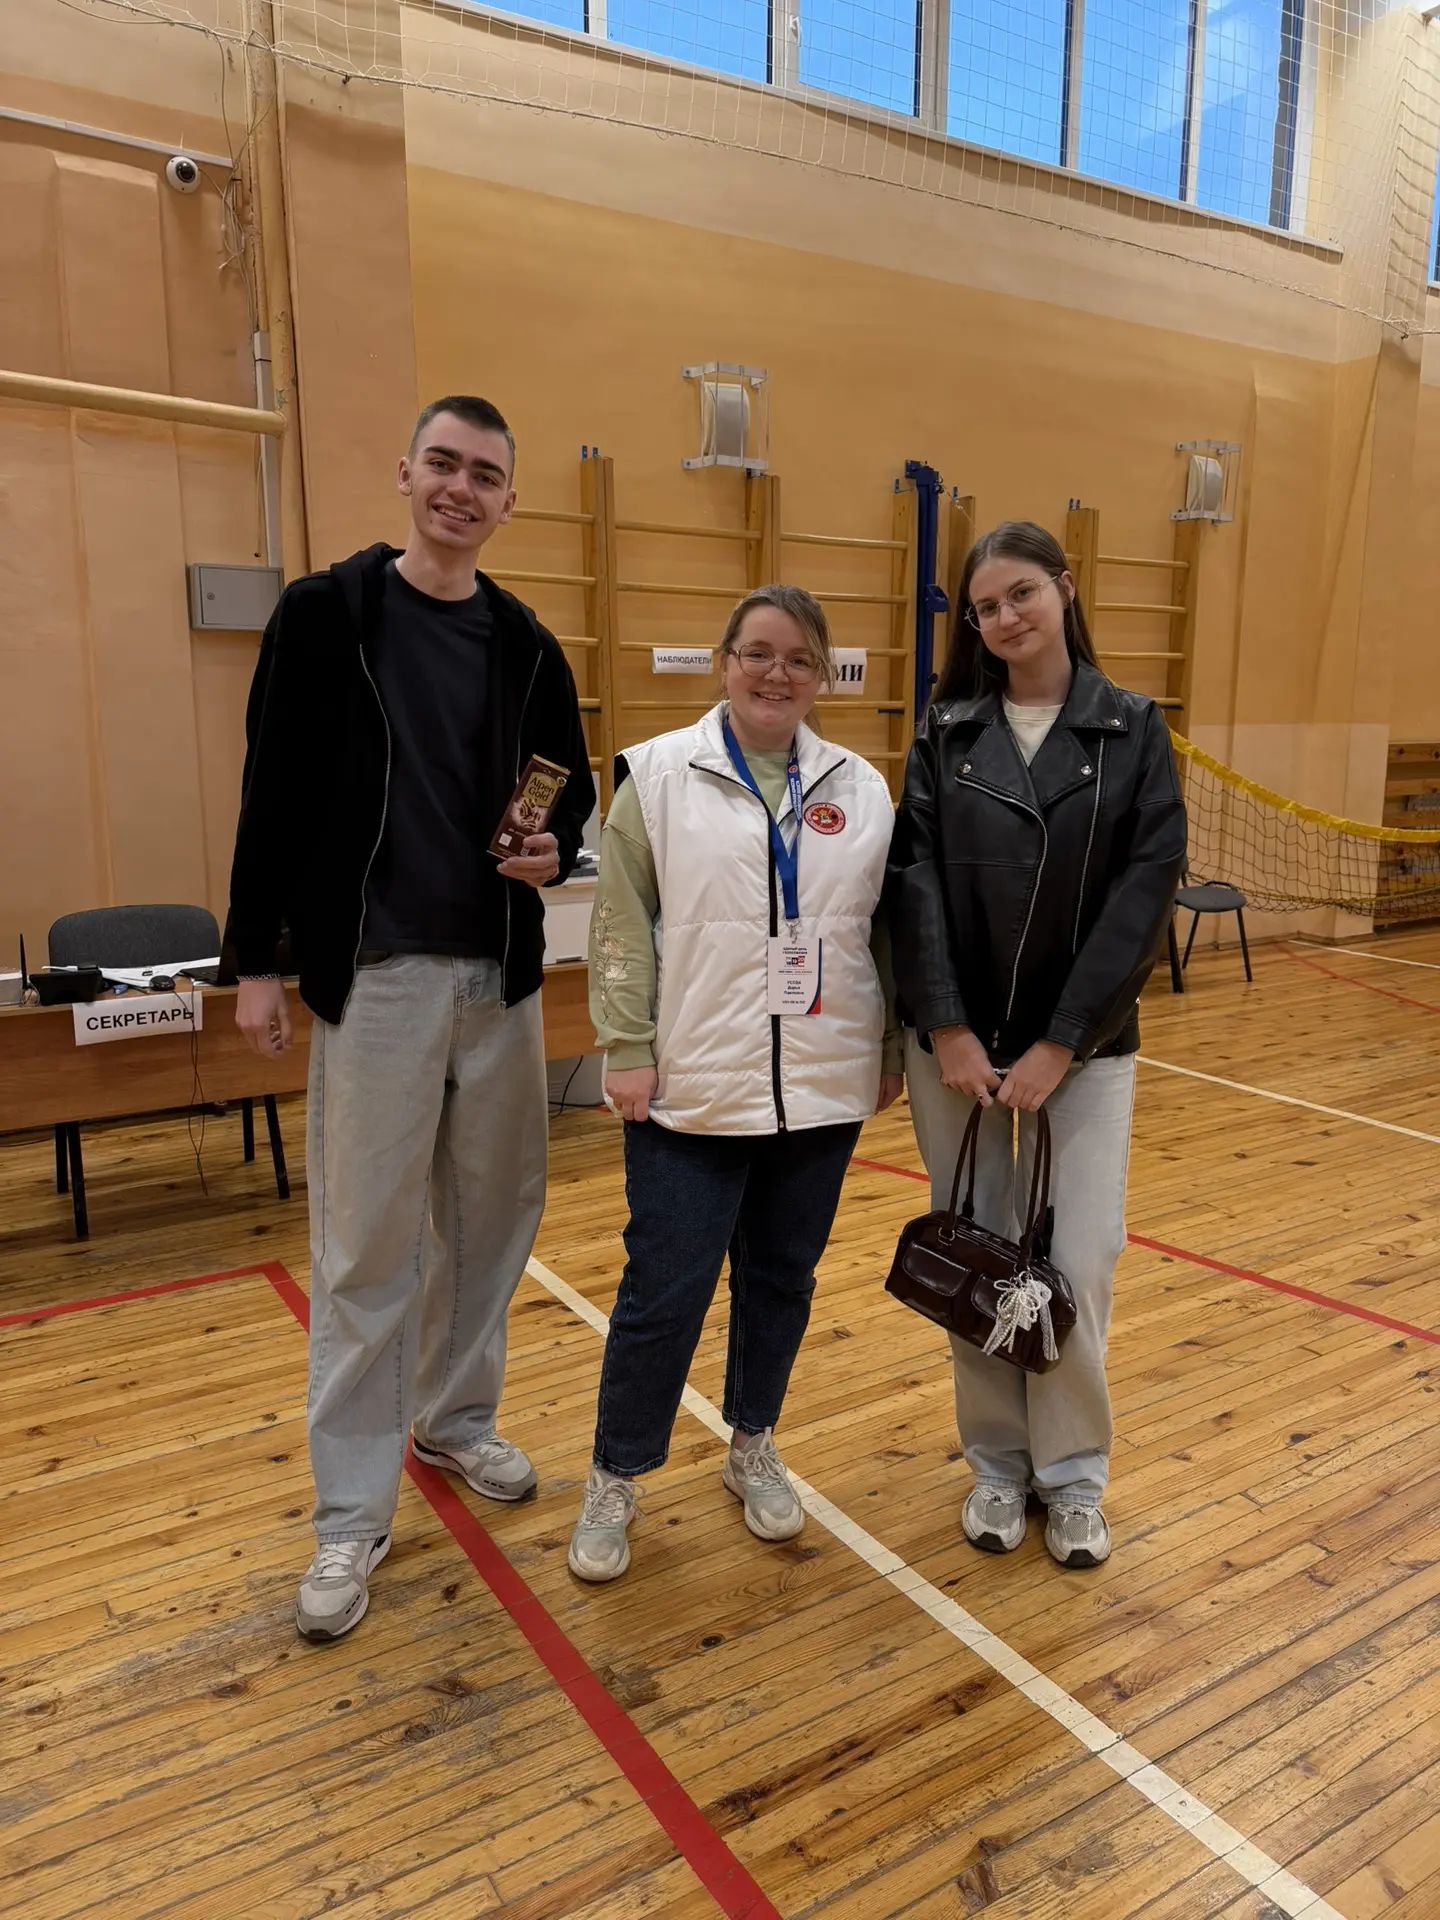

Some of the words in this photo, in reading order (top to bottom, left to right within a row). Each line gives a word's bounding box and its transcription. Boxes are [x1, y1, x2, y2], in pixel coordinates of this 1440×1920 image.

[832, 664, 864, 682] МИ
[528, 786, 549, 801] Gold
[529, 777, 554, 794] Alpen
[86, 1008, 194, 1031] СЕКРЕТАРЬ
